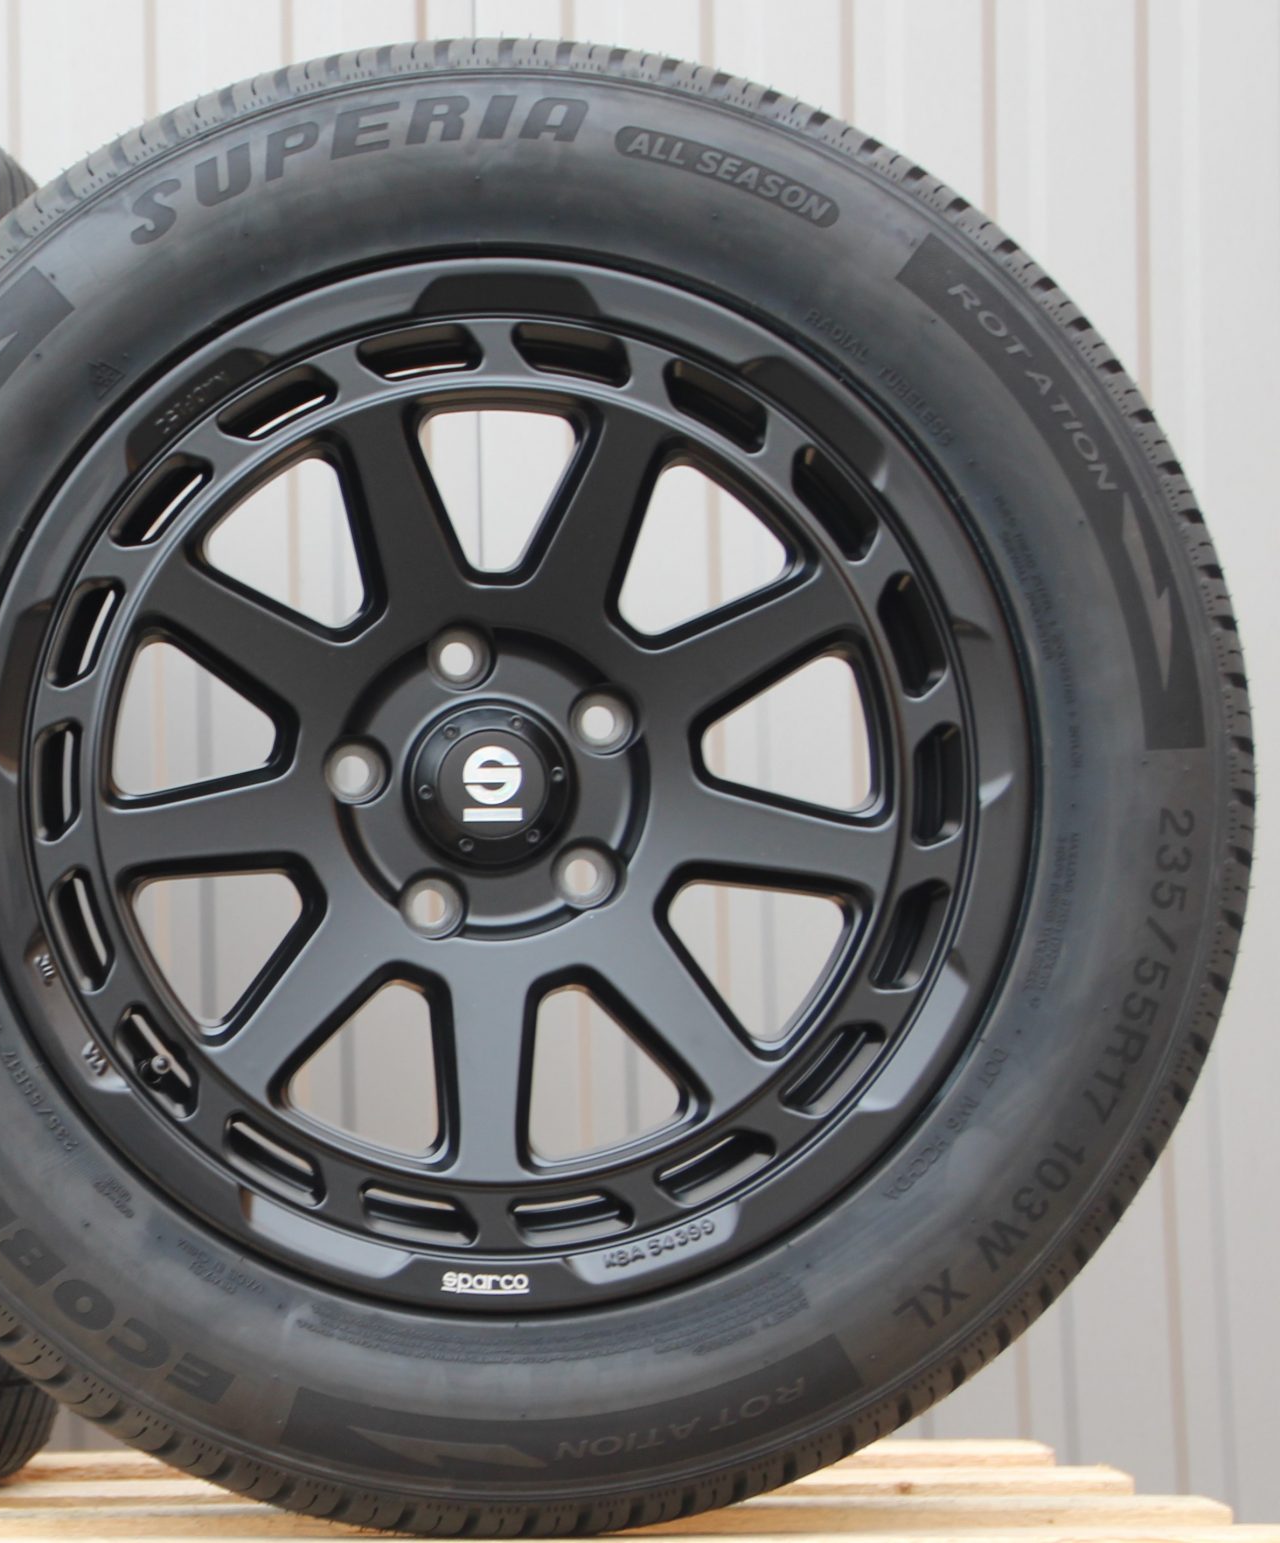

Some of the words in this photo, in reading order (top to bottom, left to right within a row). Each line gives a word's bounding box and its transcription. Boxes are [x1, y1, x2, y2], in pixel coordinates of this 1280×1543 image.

[131, 95, 589, 245] SUPERIA
[625, 128, 690, 166] ALL
[694, 147, 833, 225] SEASON
[1071, 806, 1196, 1129] 235/55R17
[604, 1243, 648, 1269] KBA
[648, 1219, 715, 1256] 54399
[966, 1129, 1092, 1273] 103W
[441, 1271, 529, 1294] sparco
[889, 1265, 972, 1342] XL
